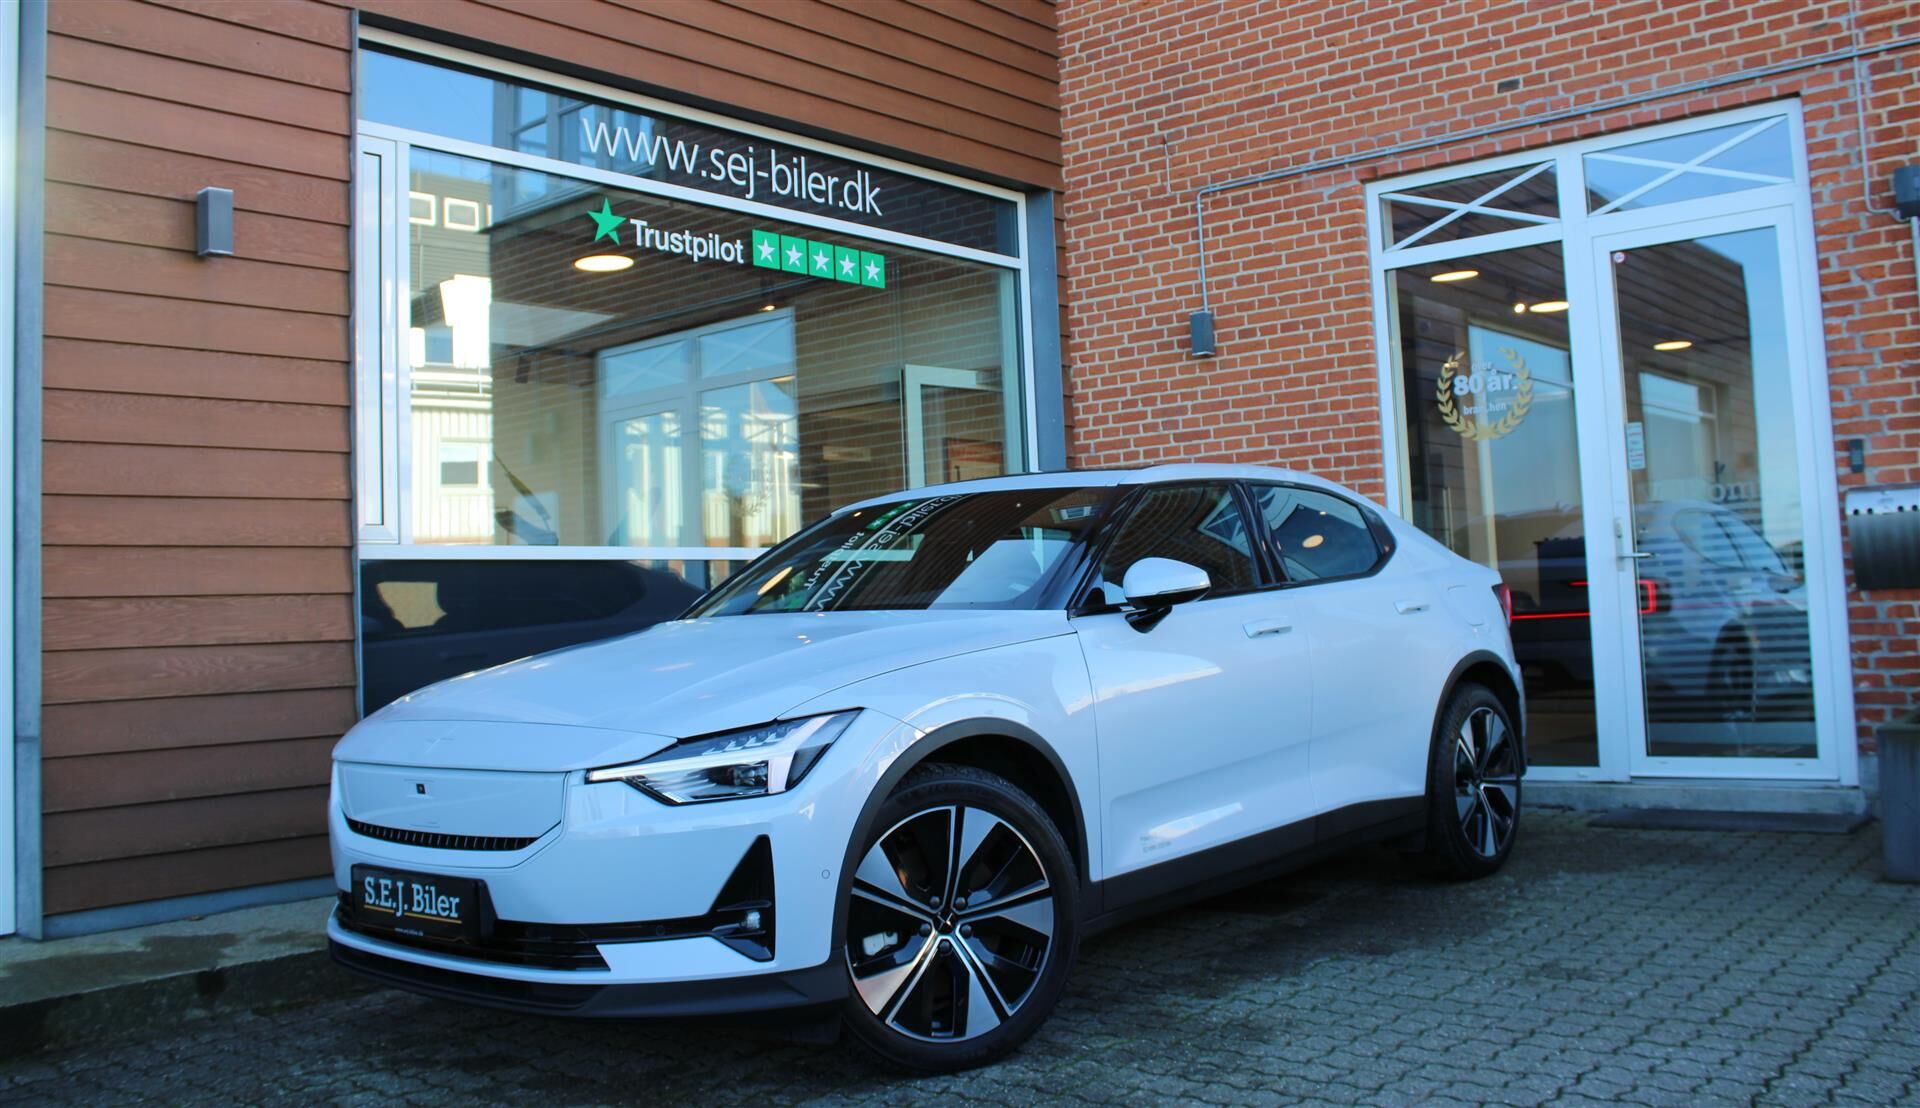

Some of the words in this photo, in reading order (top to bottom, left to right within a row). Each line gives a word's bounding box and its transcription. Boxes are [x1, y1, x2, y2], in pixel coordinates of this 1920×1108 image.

[583, 118, 882, 216] www.sej-biler.dk
[630, 218, 744, 263] Trustpilot
[1453, 374, 1482, 396] 80
[364, 877, 408, 917] S.E.J.
[412, 884, 460, 918] Biler
